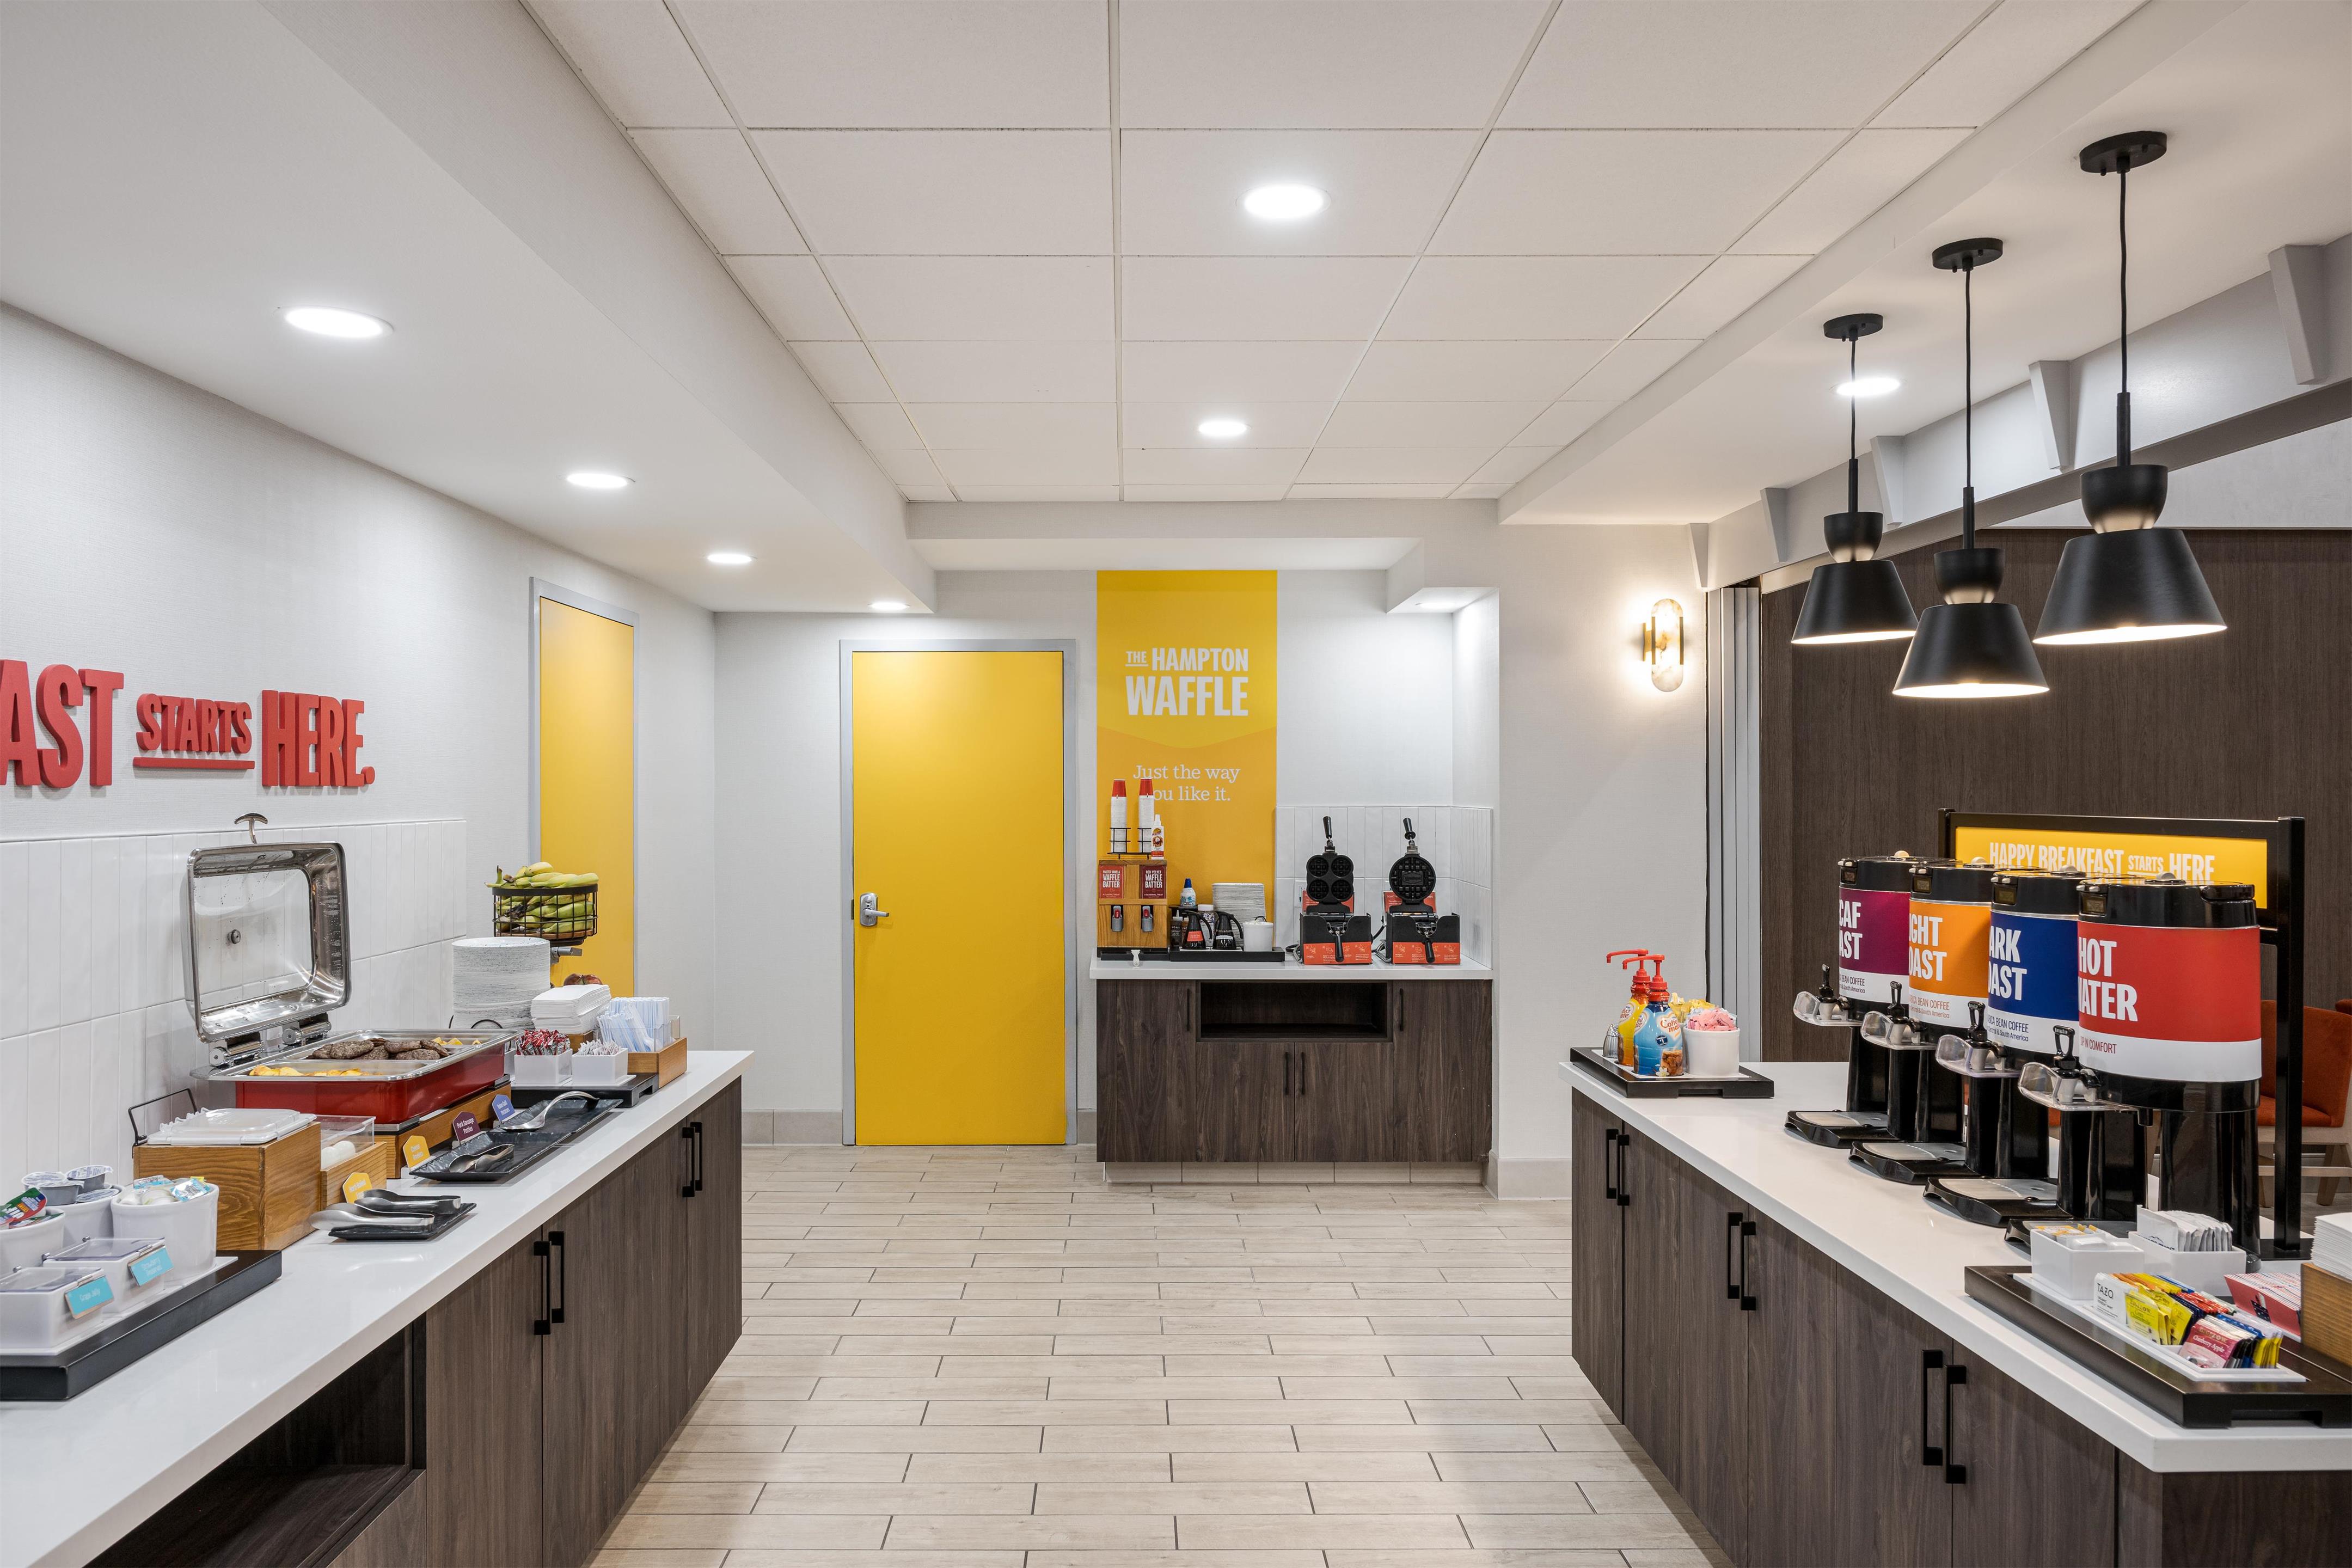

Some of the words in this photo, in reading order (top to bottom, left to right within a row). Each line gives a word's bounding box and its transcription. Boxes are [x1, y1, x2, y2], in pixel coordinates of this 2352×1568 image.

[1126, 651, 1147, 664] THE
[1152, 648, 1248, 671] HAMPTON
[1125, 676, 1248, 716] WAFFLE
[136, 693, 253, 754] STARTS
[262, 690, 375, 787] HERE.
[1133, 765, 1168, 779] Just
[1173, 764, 1200, 779] the
[1205, 768, 1241, 783] way
[1154, 789, 1173, 801] ou
[1178, 786, 1210, 801] like
[1215, 786, 1230, 801] it.
[1990, 842, 2035, 869] HAPPY
[2038, 845, 2124, 877] BREAKFAST
[2128, 855, 2164, 872] STARTS
[2170, 853, 2215, 884] HERE
[2079, 936, 2117, 977] HOT
[1849, 976, 1865, 986] COFFEE
[1918, 997, 1929, 1007] BEAN
[1930, 1000, 1950, 1010] COFFEE
[1921, 1007, 1931, 1015] South
[1931, 1010, 1950, 1019] America
[1995, 1018, 2007, 1029] BEAN
[2008, 1021, 2029, 1033] COFFEE
[2000, 1030, 2010, 1038] South
[2010, 1032, 2029, 1042] America
[2089, 1039, 2117, 1054] COMFORT
[463, 1117, 475, 1127] Sausage
[463, 1126, 474, 1135] Patties
[2097, 1283, 2114, 1300] TAZO
[2192, 1334, 2212, 1349] Cranberry
[2212, 1342, 2225, 1353] Apple
